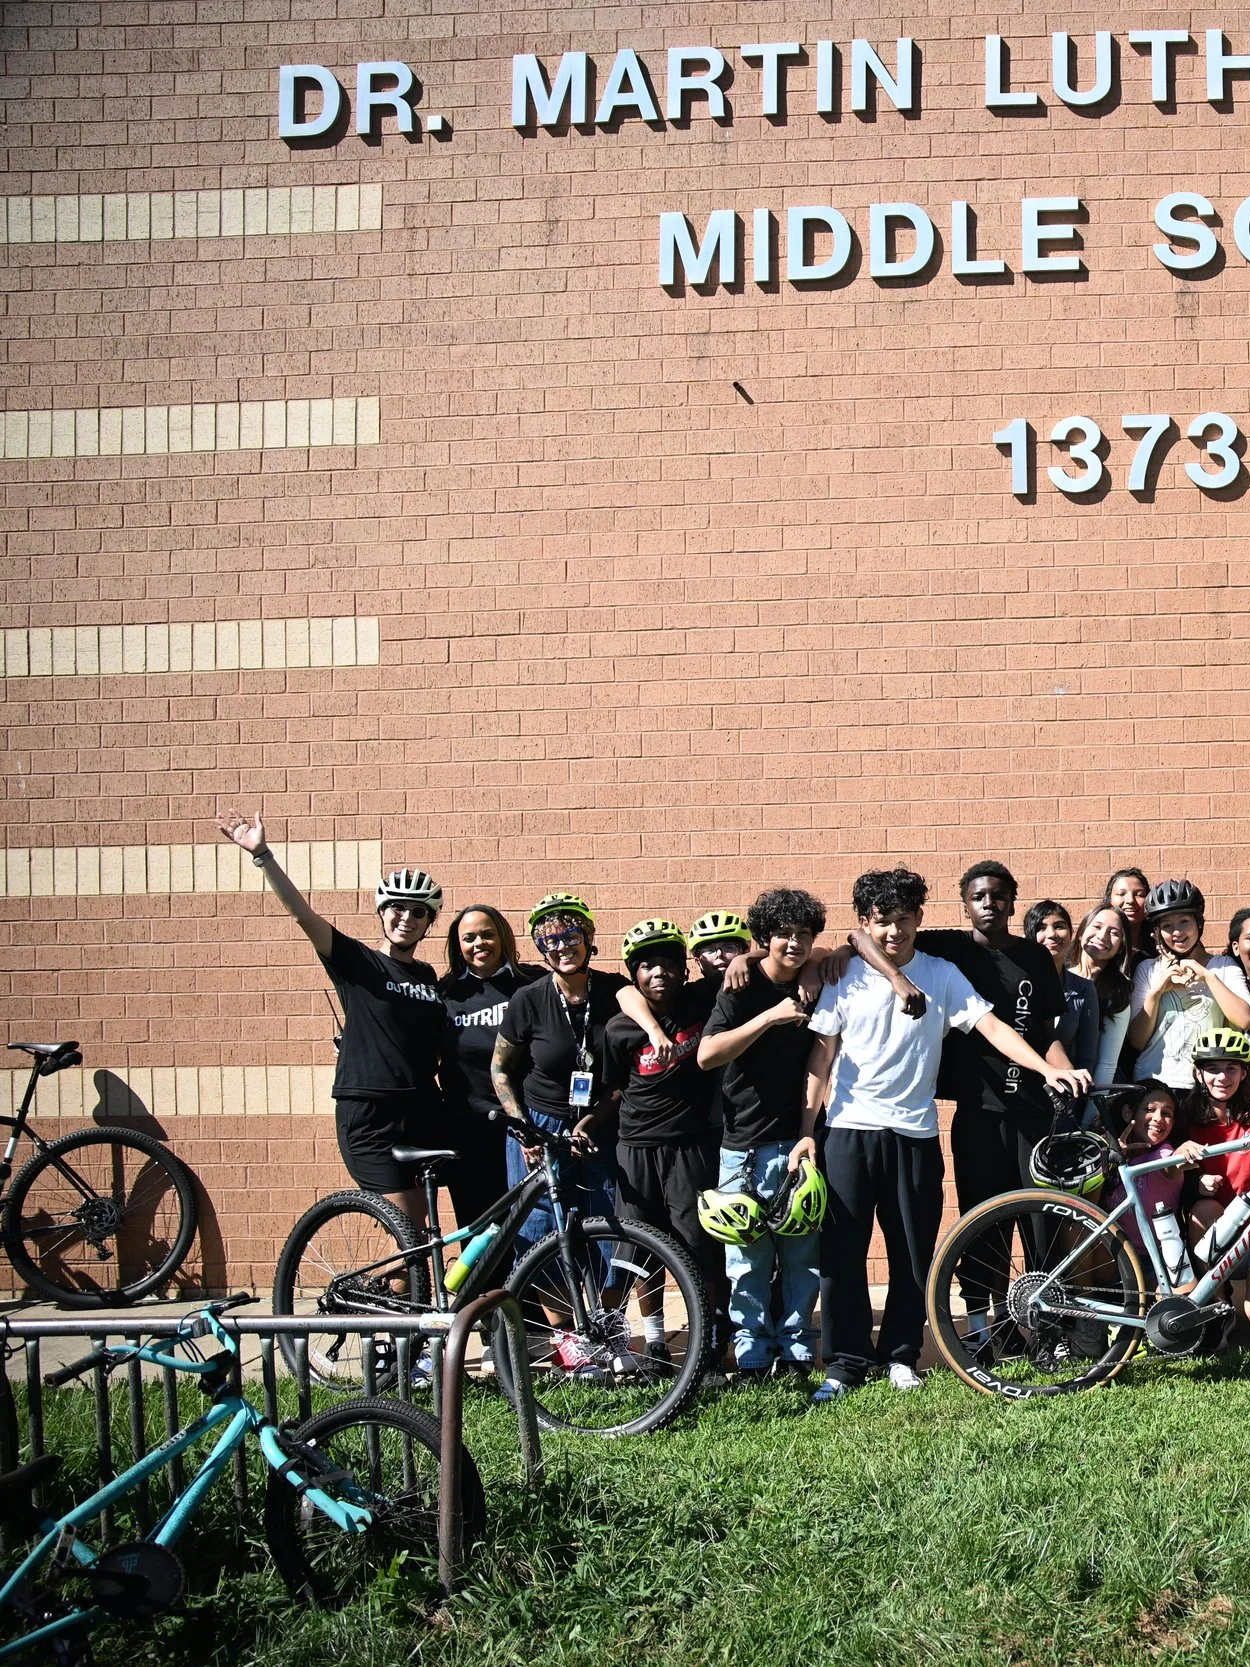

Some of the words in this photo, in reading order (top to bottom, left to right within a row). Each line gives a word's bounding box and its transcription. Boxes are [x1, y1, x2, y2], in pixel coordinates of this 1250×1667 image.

[278, 61, 442, 138] DR.
[512, 37, 914, 128] MARTIN
[659, 196, 1081, 286] MIDDLE
[1004, 1059, 1022, 1094] lein
[1042, 1203, 1108, 1235] rova
[965, 1366, 1032, 1398] roval
